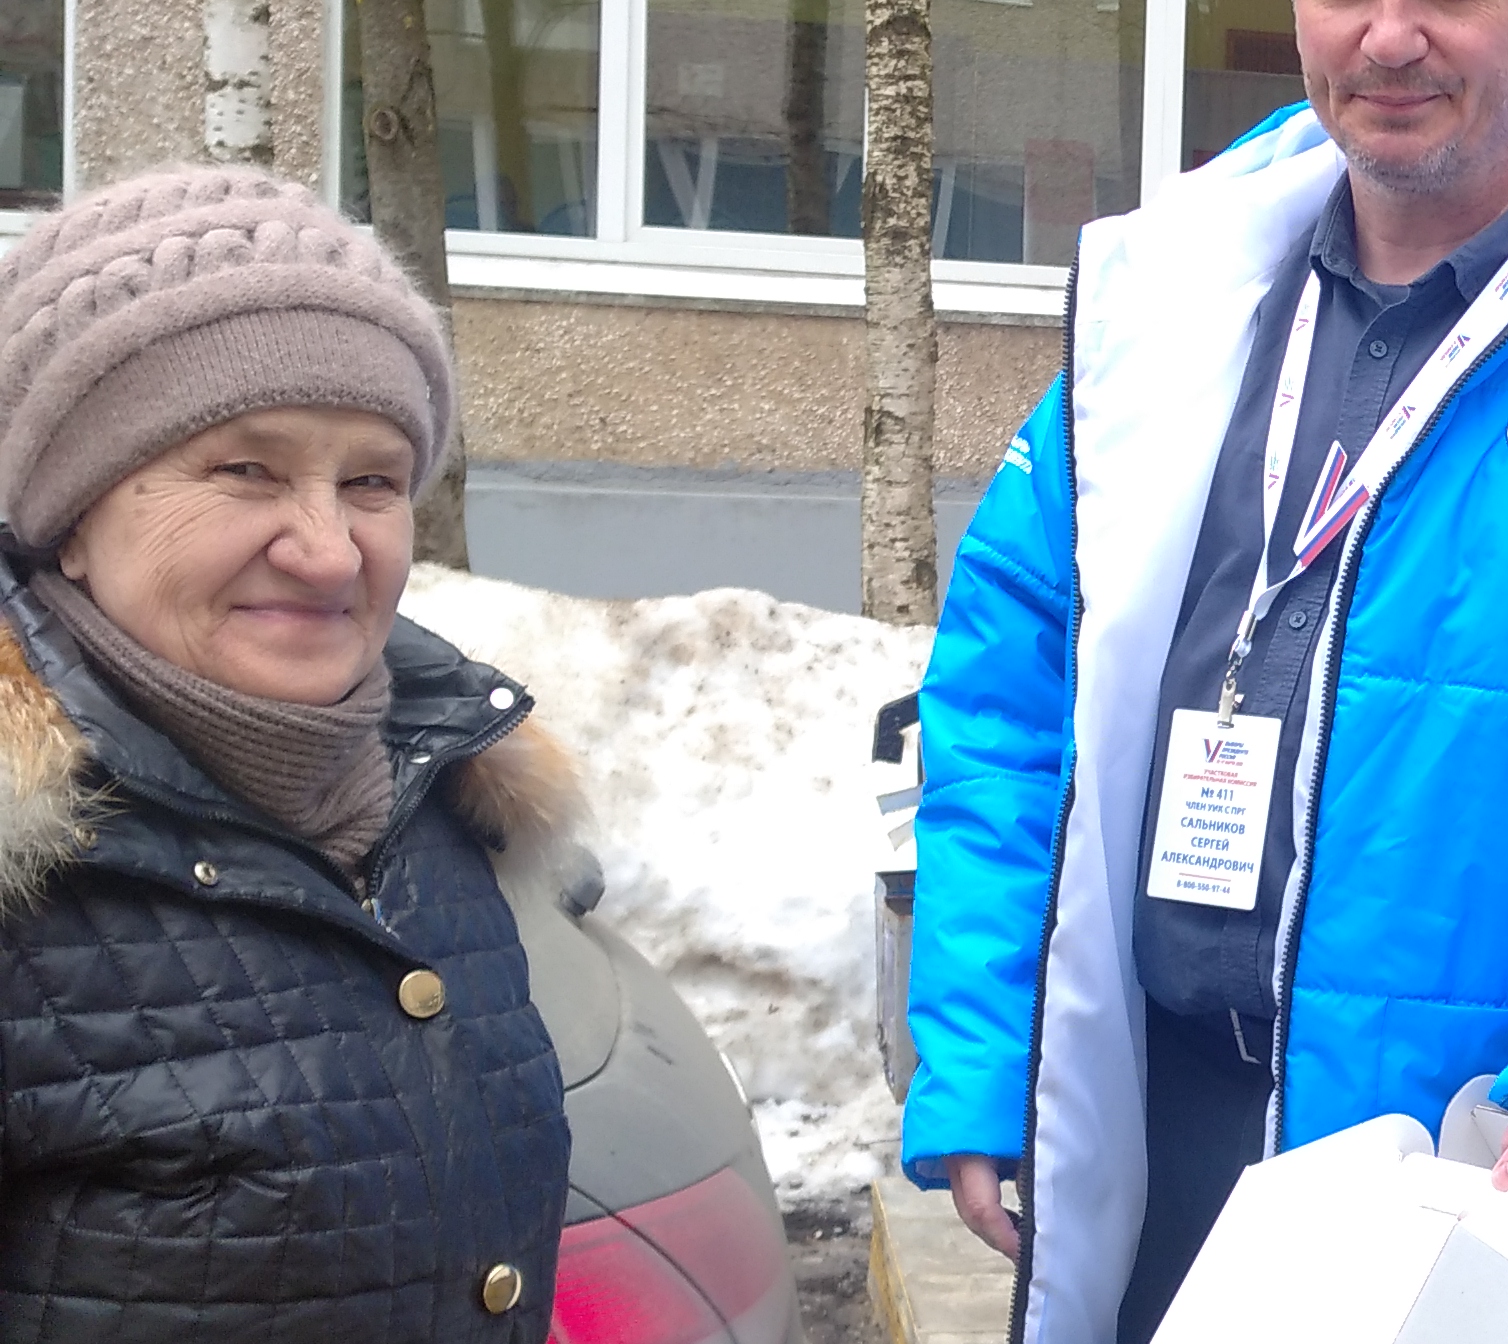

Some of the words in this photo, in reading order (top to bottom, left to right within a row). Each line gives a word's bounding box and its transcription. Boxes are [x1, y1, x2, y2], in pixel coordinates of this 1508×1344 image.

[1200, 786, 1215, 798] №
[1216, 788, 1234, 801] 411
[1185, 800, 1206, 811] ЧЛЕН
[1207, 803, 1223, 813] УИК
[1230, 806, 1246, 815] ПРГ
[1180, 816, 1246, 835] САЛЬНИКОВ
[1190, 836, 1230, 852] СЕРГЕЙ
[1161, 850, 1255, 874] АЛЕКСАНДРОВИЧ
